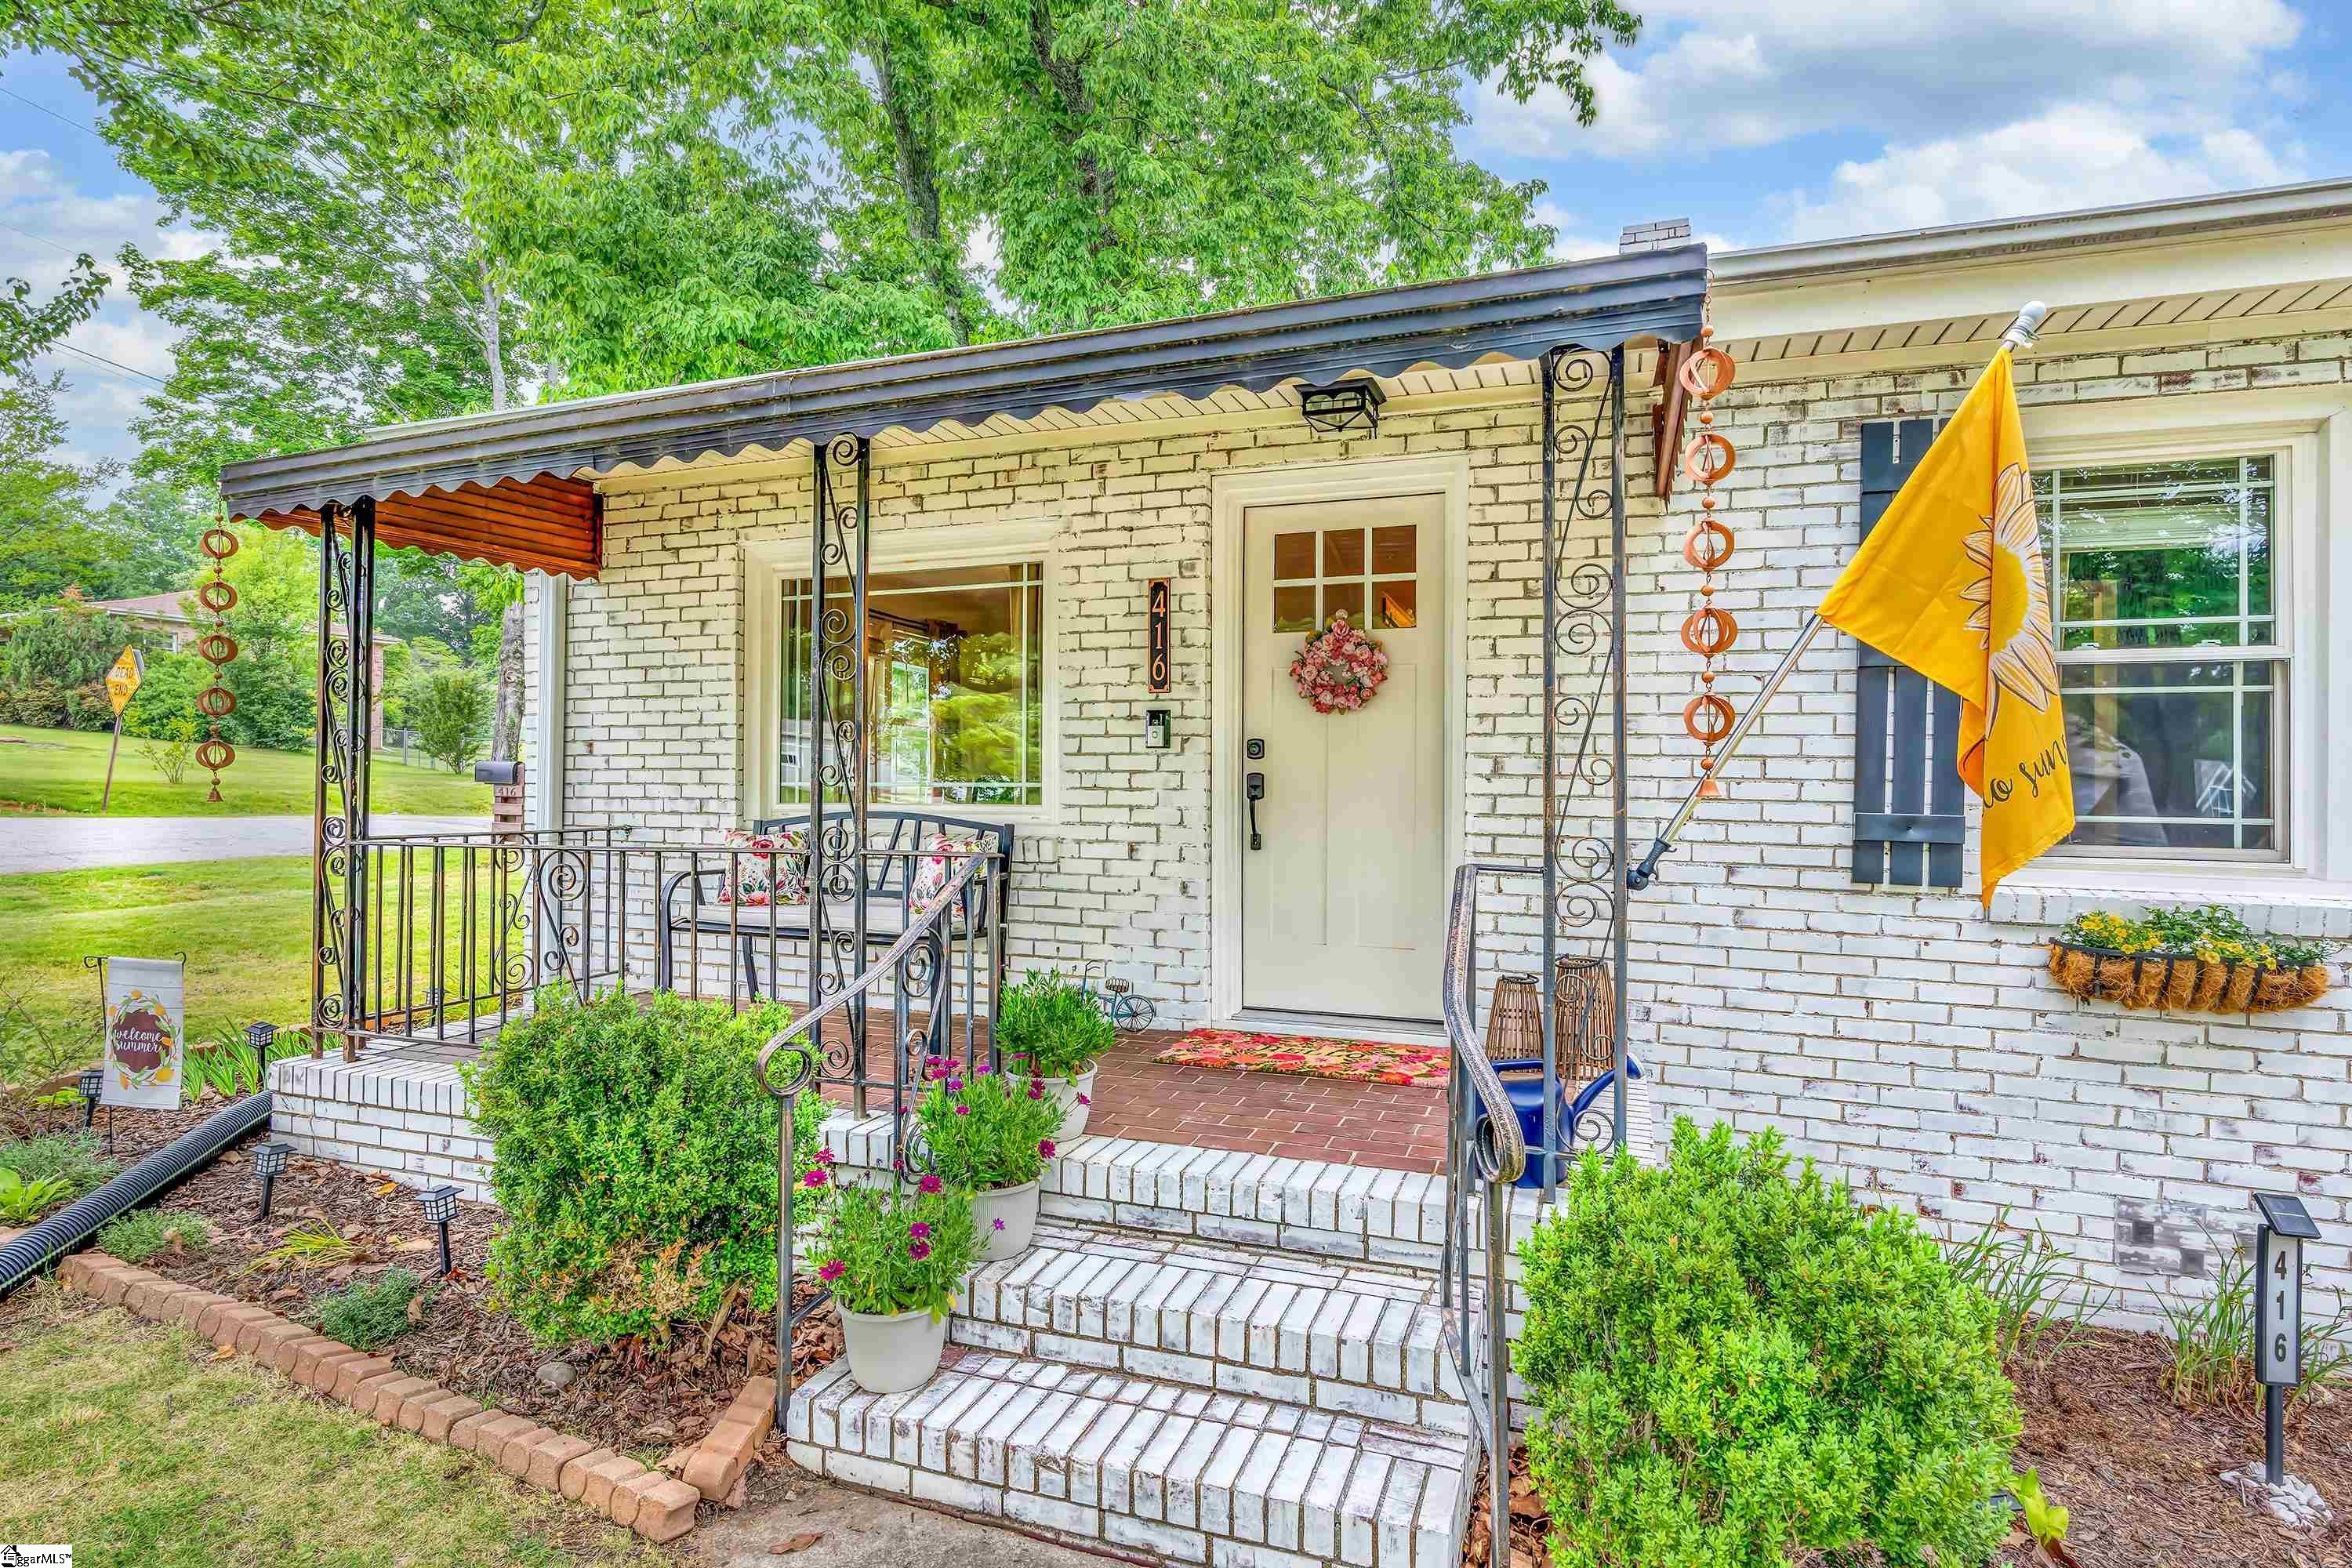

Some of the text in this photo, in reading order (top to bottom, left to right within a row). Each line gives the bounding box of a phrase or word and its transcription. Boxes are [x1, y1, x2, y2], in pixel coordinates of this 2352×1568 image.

[1152, 590, 1167, 681] 416
[115, 666, 134, 679] DEAD
[114, 684, 128, 696] END
[497, 786, 517, 797] 416
[113, 1027, 163, 1042] welcome
[114, 1040, 162, 1053] summer
[2274, 1250, 2288, 1363] 416
